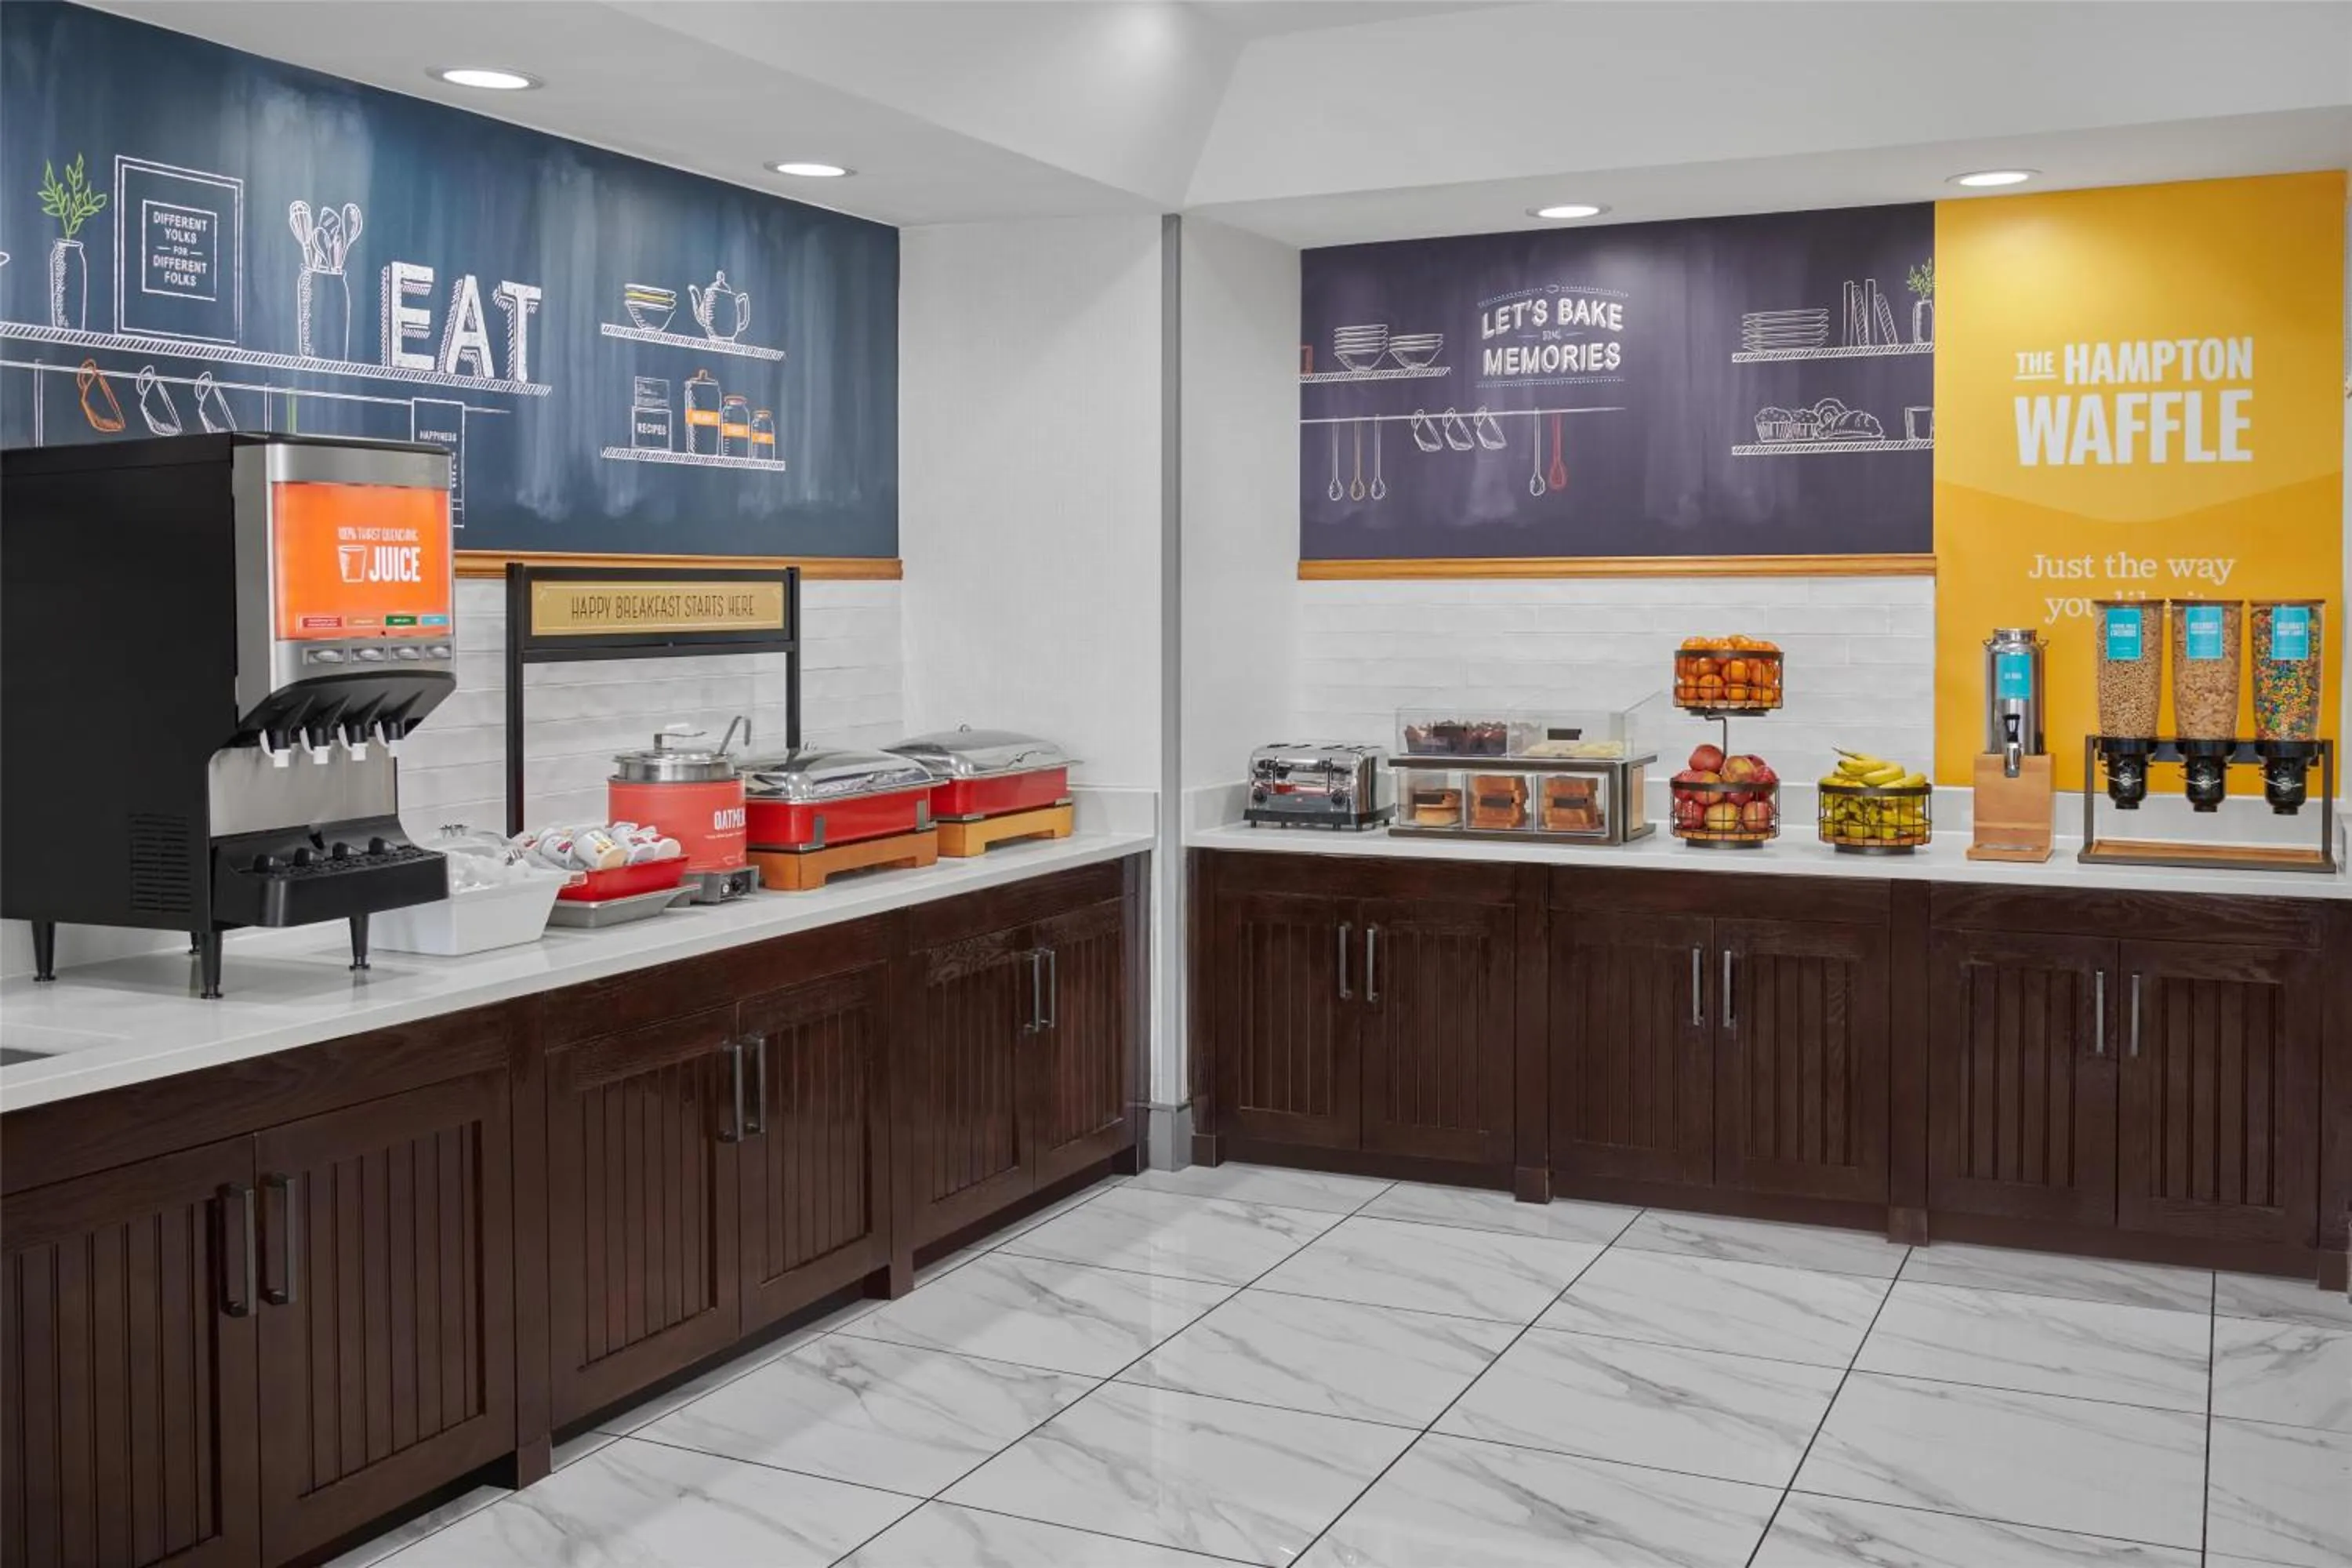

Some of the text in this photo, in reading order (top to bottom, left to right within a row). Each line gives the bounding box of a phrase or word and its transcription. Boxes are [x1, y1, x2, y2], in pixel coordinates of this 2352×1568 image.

[153, 211, 208, 232] DIFFERENT
[164, 227, 197, 245] YOLKS
[153, 254, 208, 274] DIFFERENT
[164, 270, 197, 287] FOLKS
[380, 261, 542, 383] EAT
[1482, 297, 1624, 339] LET'S BAKE
[1483, 343, 1621, 376] MEMORIES
[2015, 336, 2253, 385] THE HAMPTON
[2014, 390, 2253, 466] WAFFLE
[369, 546, 421, 583] JUICE
[2029, 551, 2234, 586] Just the way
[571, 593, 755, 619] HAPPY BREAKFAST STARTS HERE
